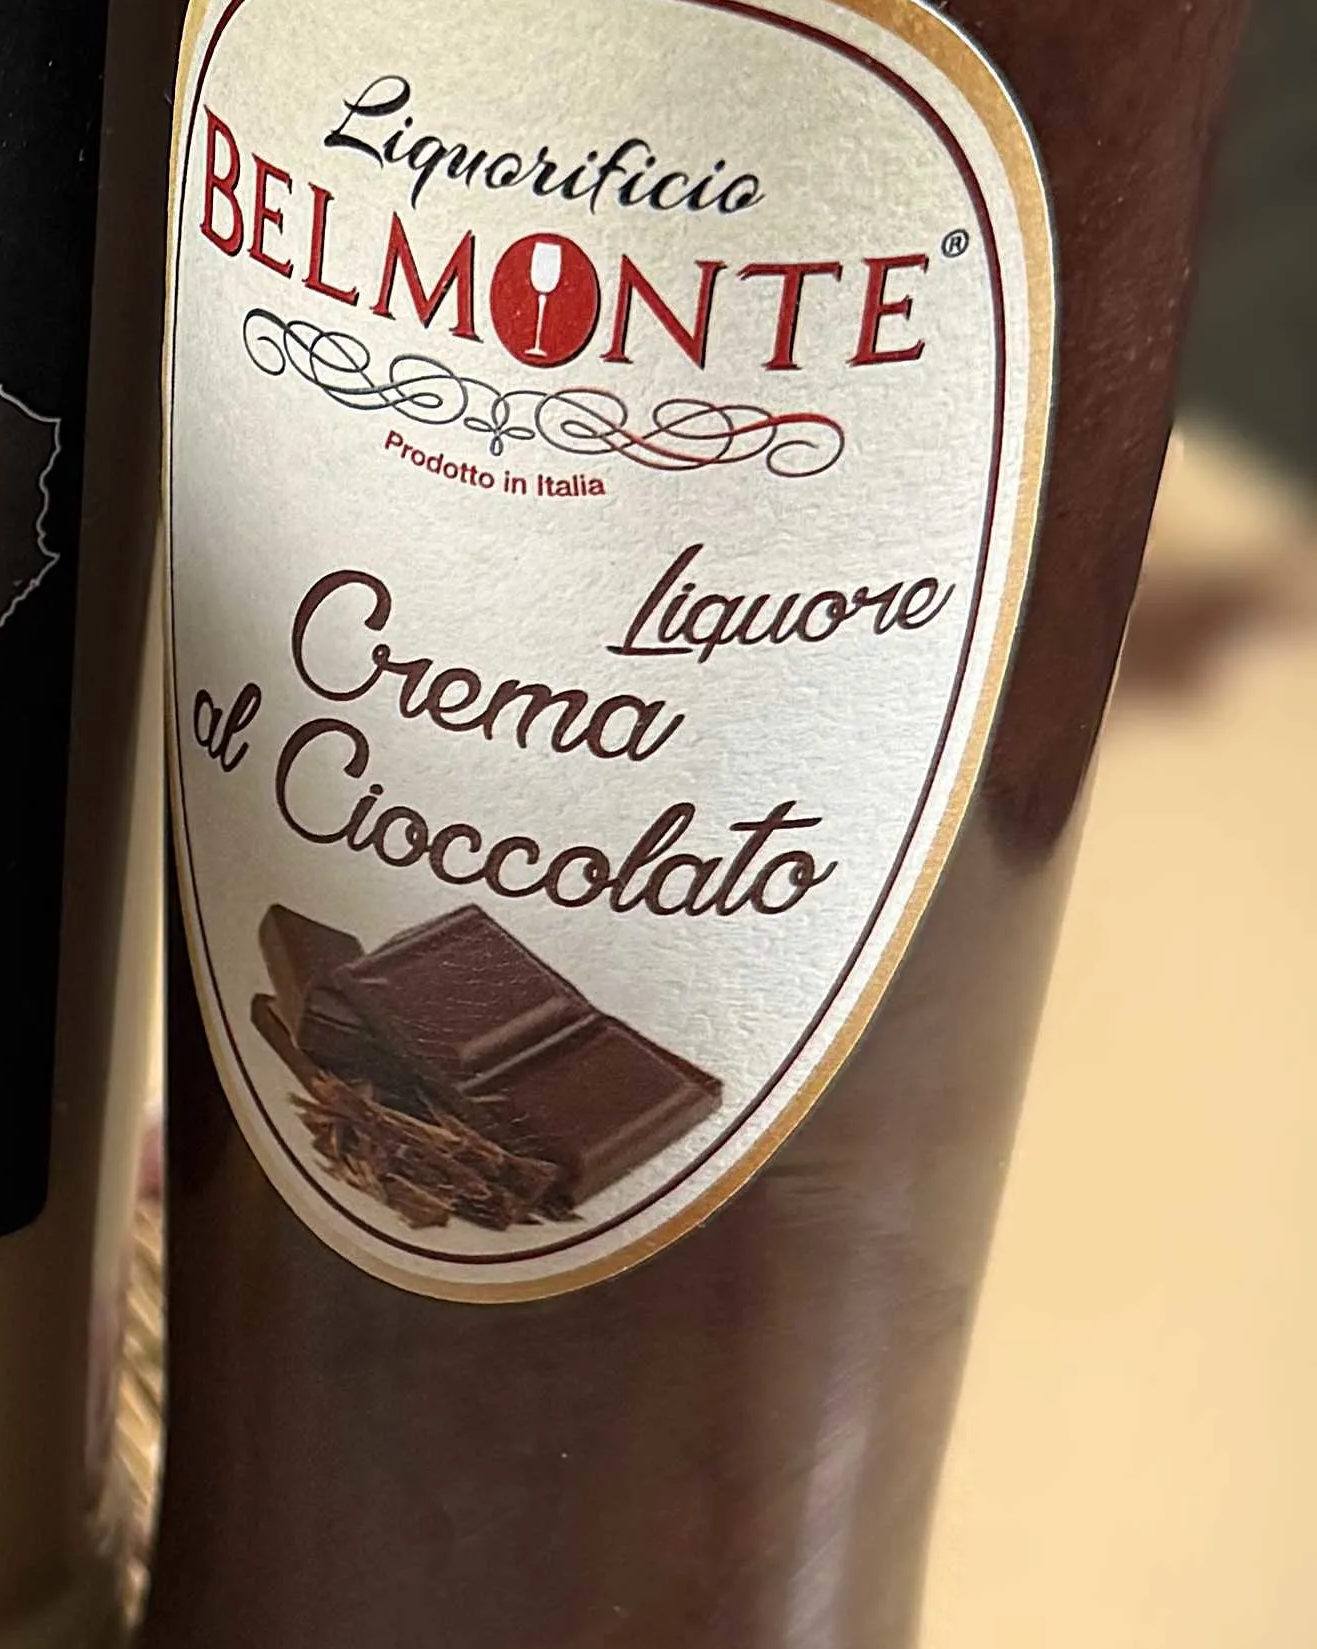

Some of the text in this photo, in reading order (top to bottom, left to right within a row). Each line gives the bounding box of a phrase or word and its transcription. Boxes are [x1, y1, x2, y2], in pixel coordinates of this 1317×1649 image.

[324, 74, 766, 214] Liquorificio
[384, 429, 606, 498] Prodotto in Italia
[291, 569, 686, 762] Crema
[608, 543, 956, 664] Liquore
[193, 683, 839, 917] al Cioccolato
